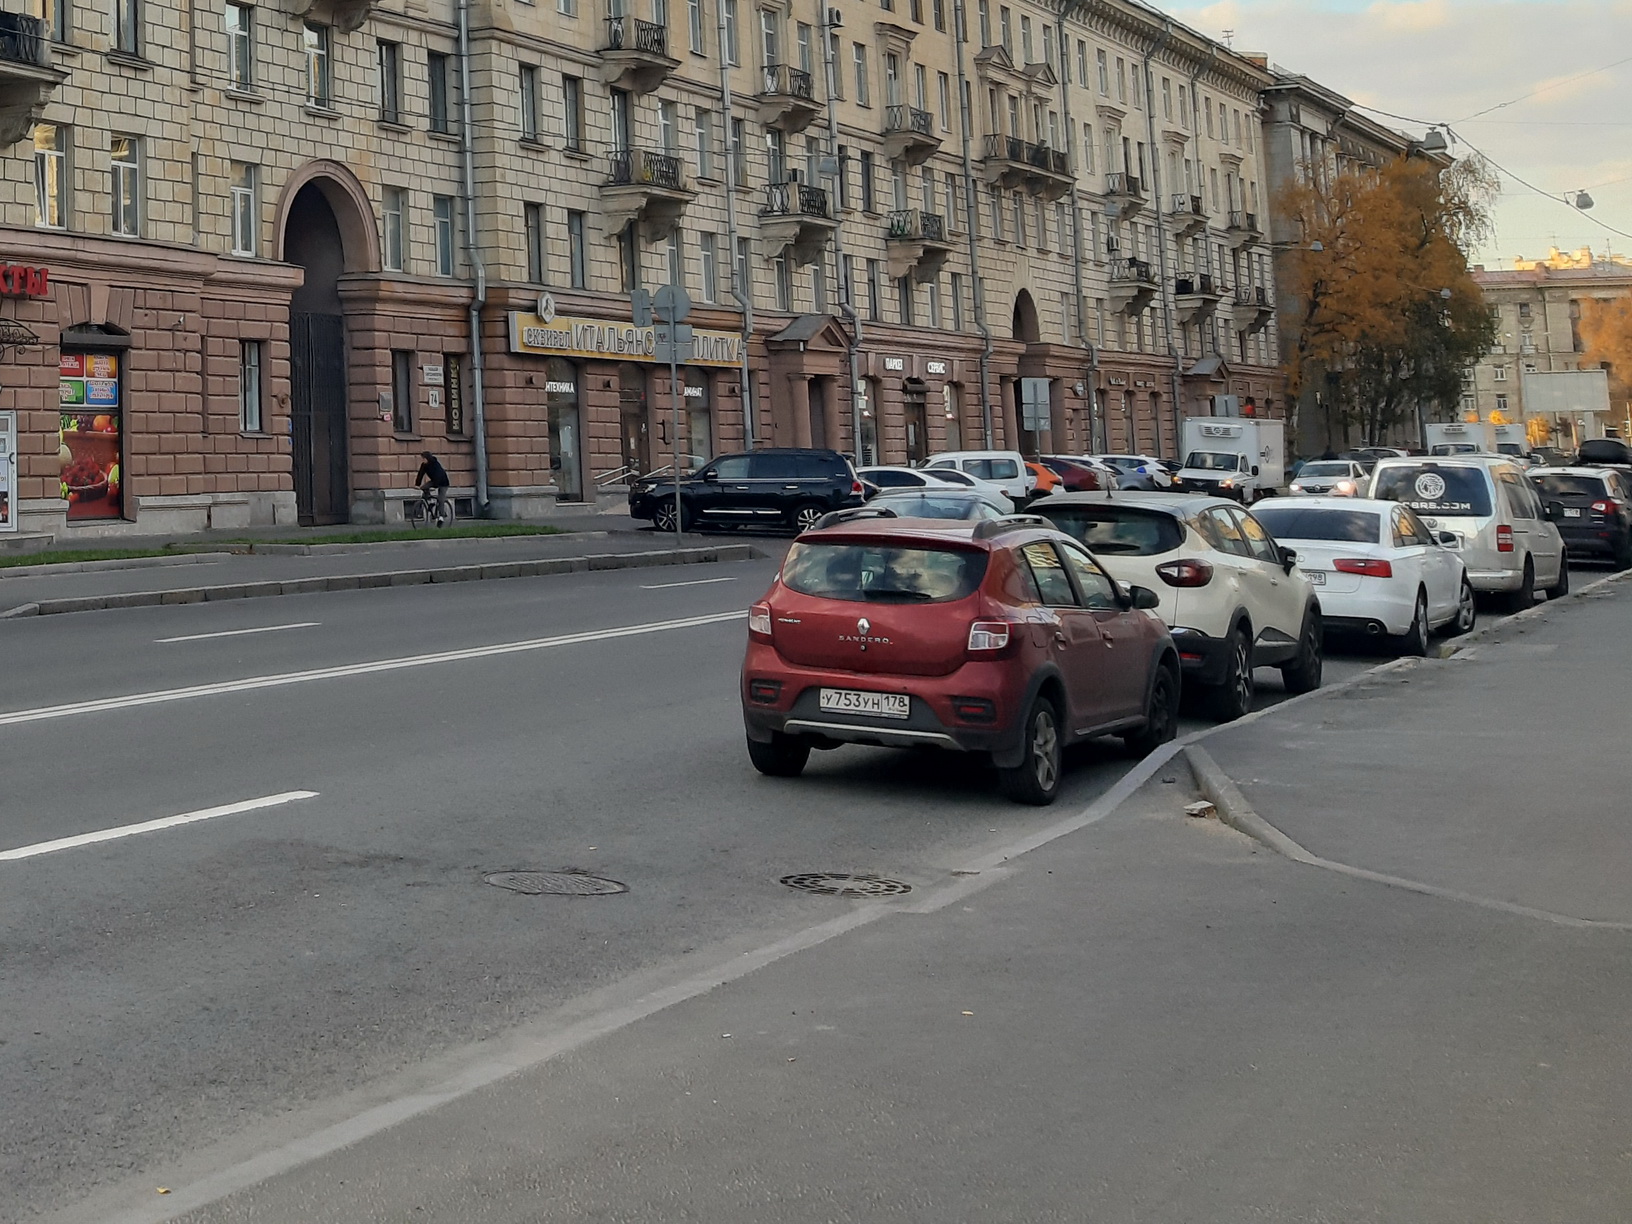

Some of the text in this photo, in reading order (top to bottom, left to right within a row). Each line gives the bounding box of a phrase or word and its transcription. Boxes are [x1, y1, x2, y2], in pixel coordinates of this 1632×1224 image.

[574, 323, 656, 356] ИТАЛЬЯНС
[692, 334, 743, 362] ПЛИТКА
[545, 381, 575, 393] НТЕХНИКА
[683, 386, 703, 397] АМИНАТ
[430, 393, 438, 405] 74
[838, 635, 890, 644] SANDERO
[884, 695, 906, 708] 178
